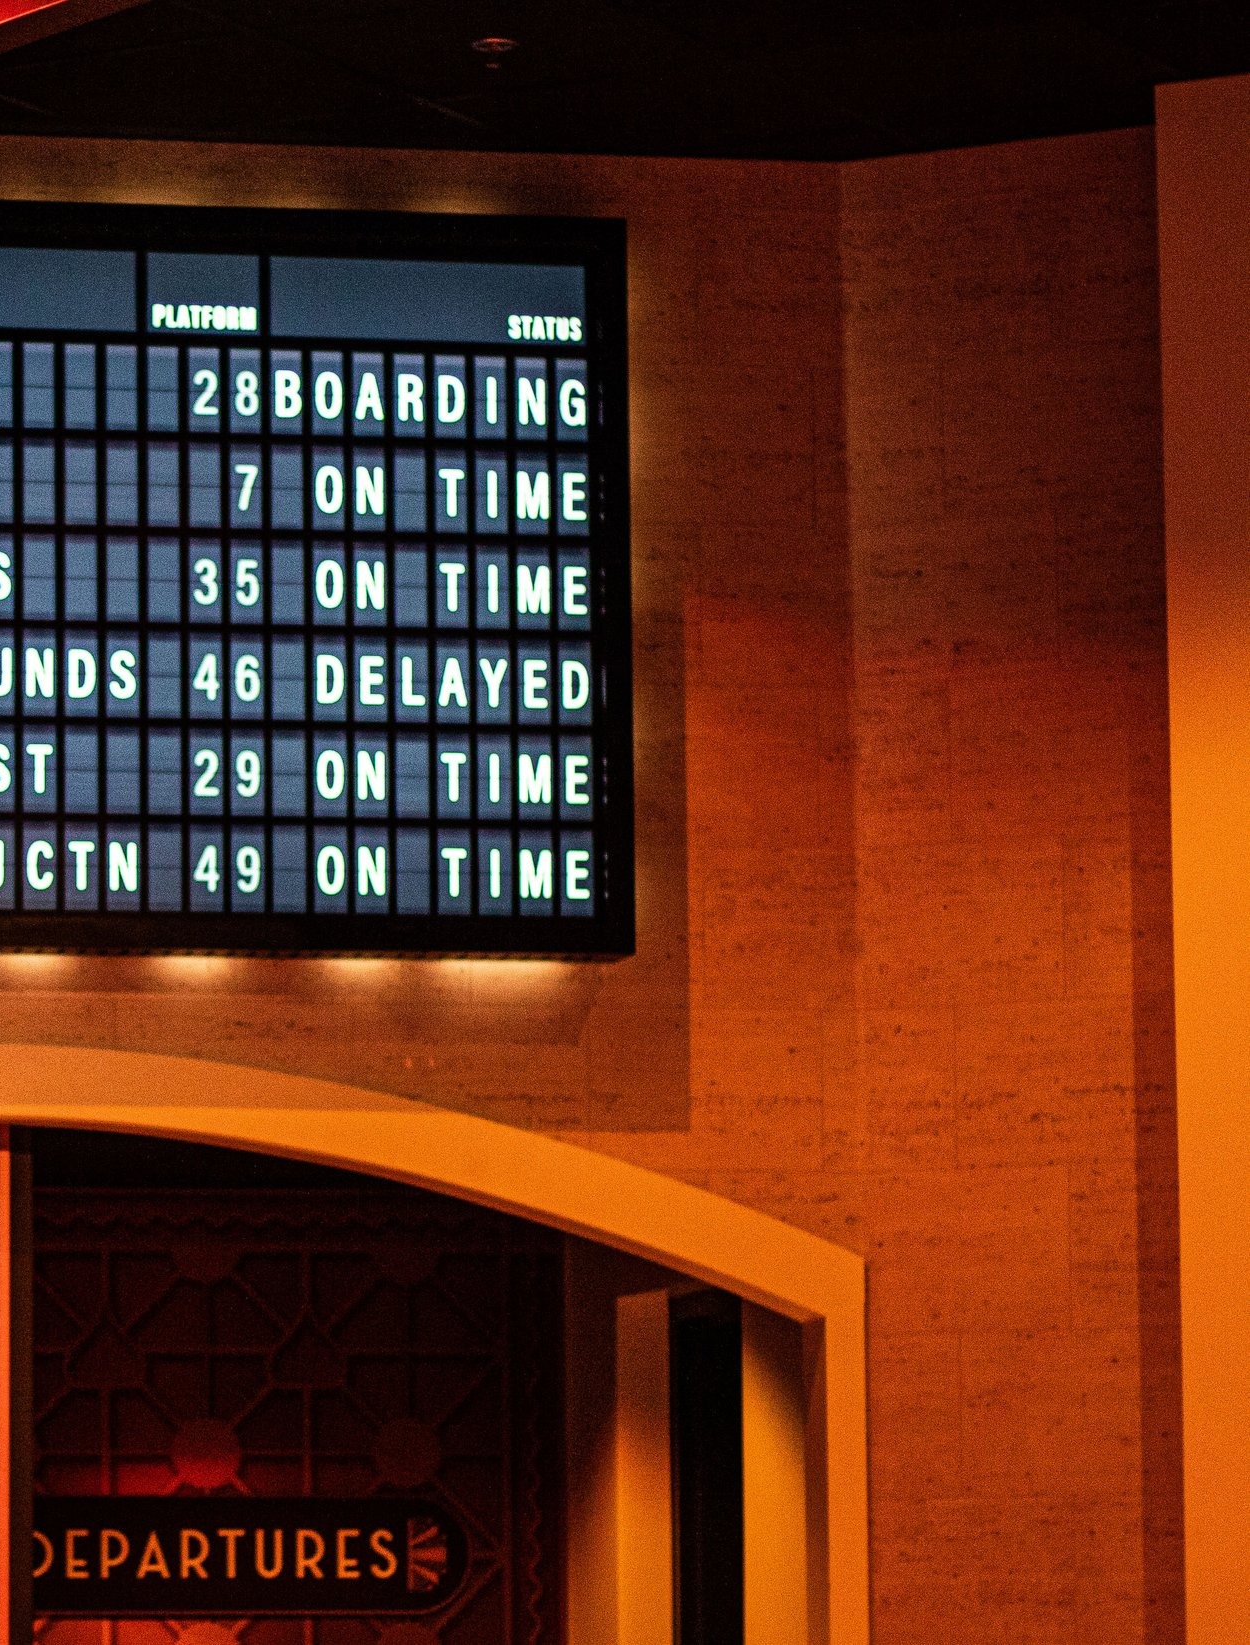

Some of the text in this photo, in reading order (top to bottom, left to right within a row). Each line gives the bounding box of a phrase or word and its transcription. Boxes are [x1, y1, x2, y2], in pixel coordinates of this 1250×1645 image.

[152, 303, 257, 331] PLATFORM
[507, 314, 583, 342] STATUS
[193, 369, 259, 416] 28
[274, 369, 586, 427] BOARDING
[235, 464, 259, 511] 7
[315, 465, 384, 515] ON
[438, 468, 587, 521] TIME
[193, 558, 260, 606] 35
[315, 559, 385, 610] ON
[438, 562, 588, 615] TIME
[192, 653, 261, 702] 46
[316, 654, 589, 710] DELAYED
[194, 749, 261, 798] 29
[316, 749, 386, 801] ON
[440, 752, 590, 805] TIME
[194, 845, 261, 893] 49
[316, 845, 386, 896] ON
[440, 847, 590, 900] TIME
